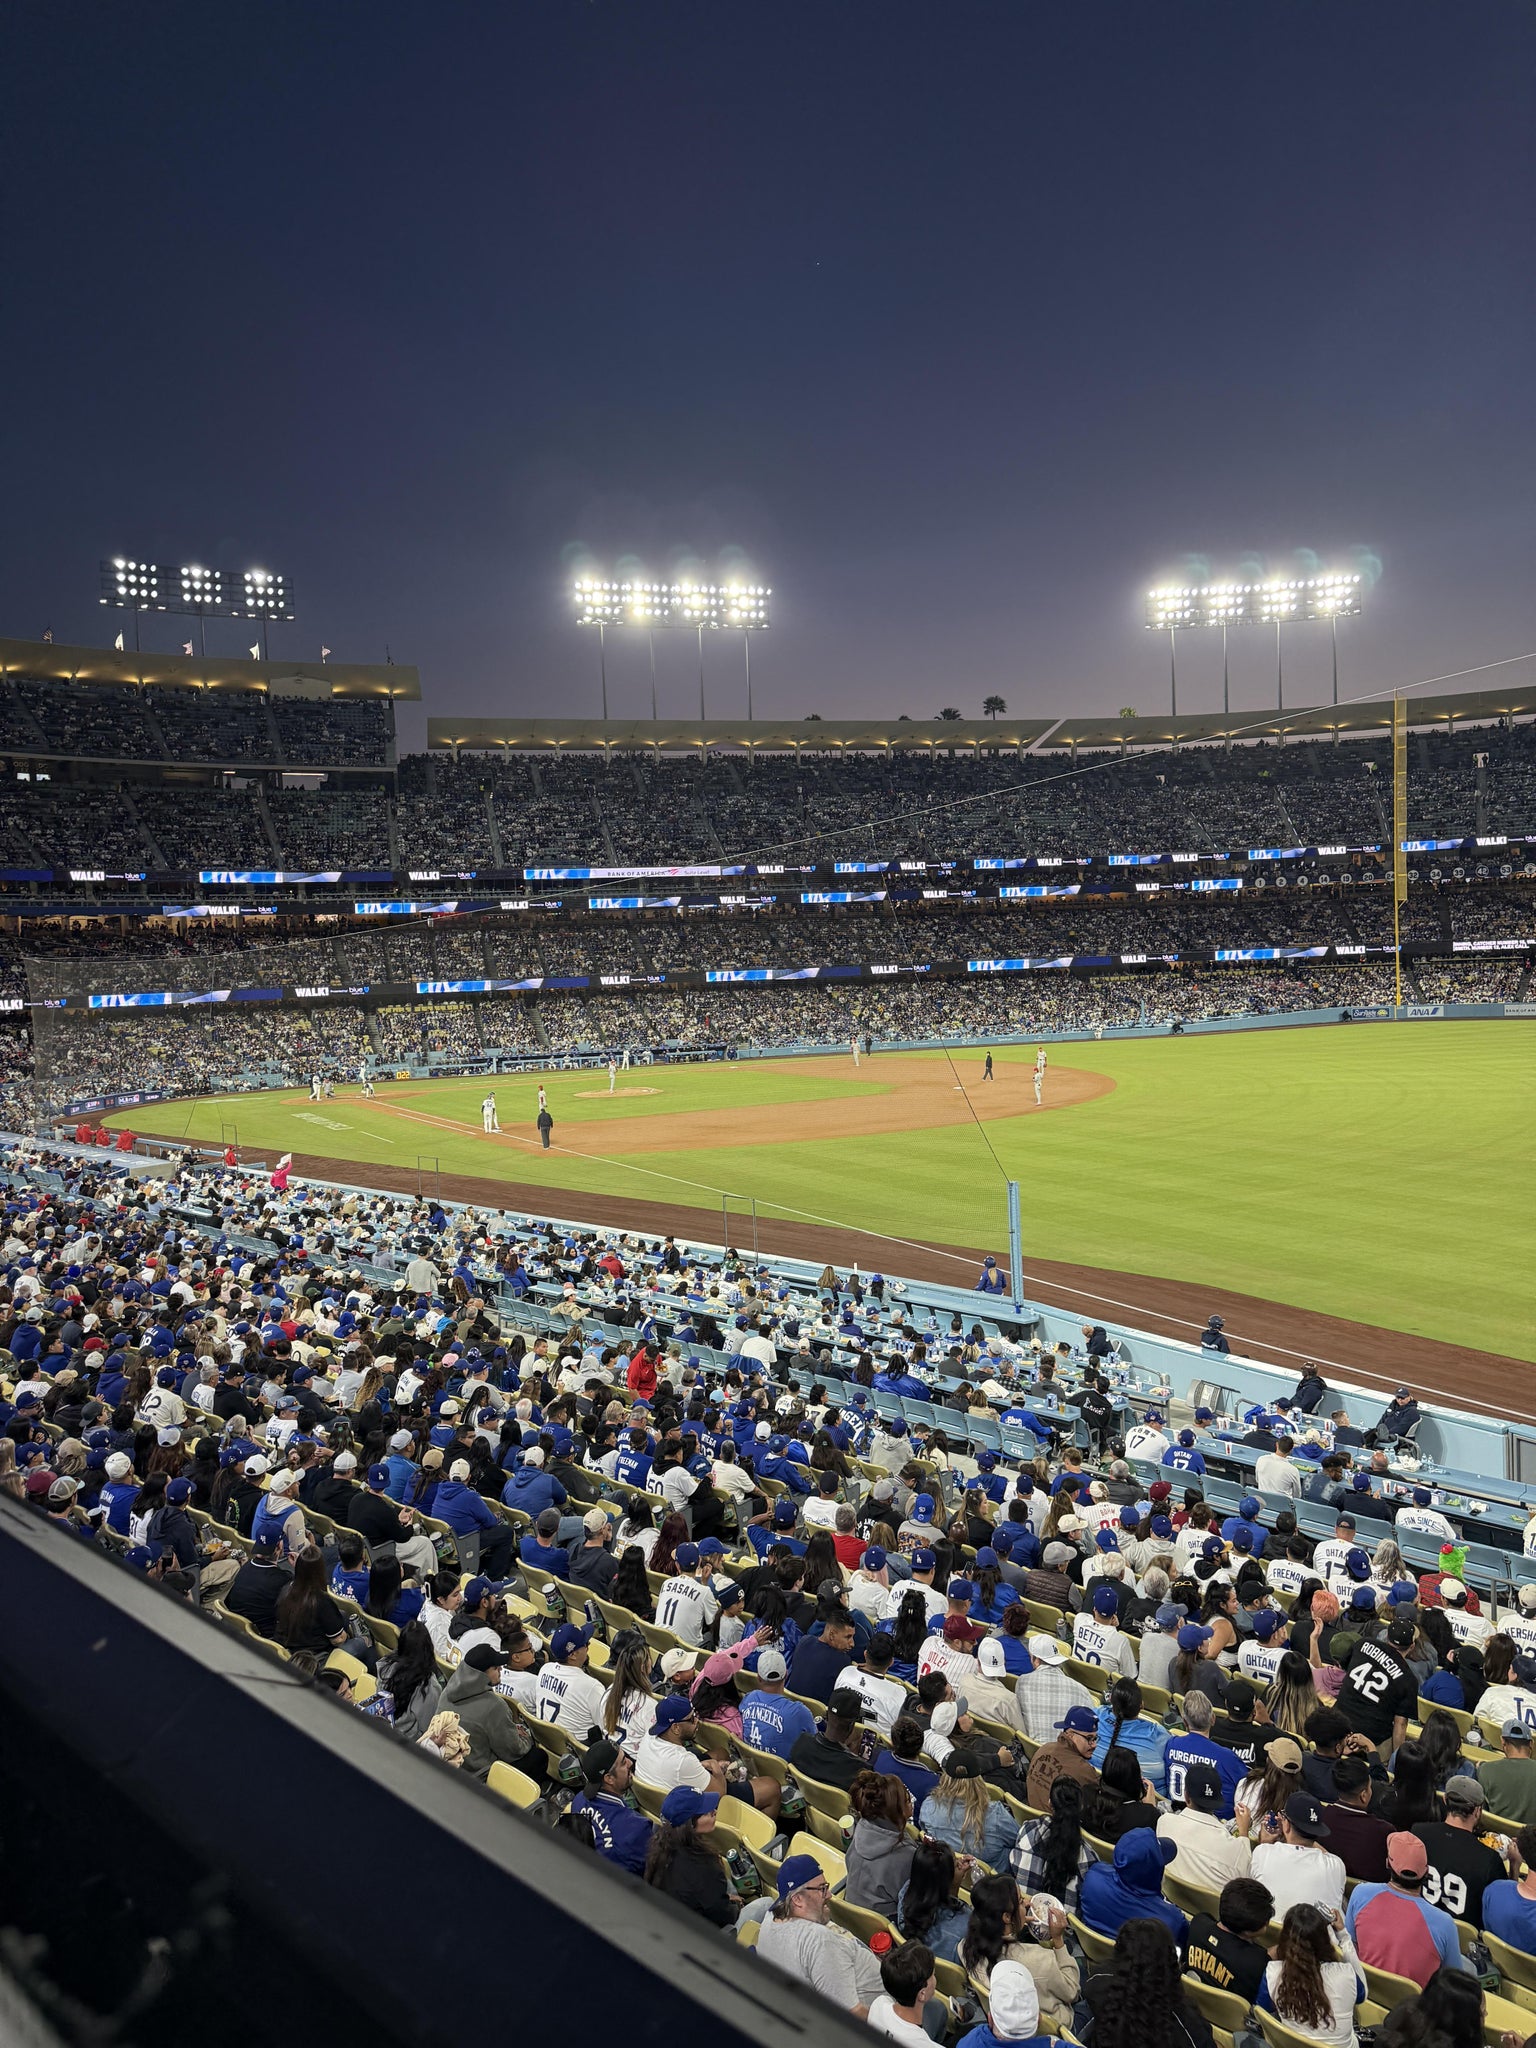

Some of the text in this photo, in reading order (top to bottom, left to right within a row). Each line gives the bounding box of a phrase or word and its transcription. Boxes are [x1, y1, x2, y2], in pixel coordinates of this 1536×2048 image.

[1410, 1008, 1429, 1016] ANA
[140, 1392, 163, 1412] 42
[1129, 1434, 1146, 1449] 17
[618, 1456, 639, 1470] FREEMAN
[1173, 1451, 1192, 1462] OHTANI
[1173, 1458, 1190, 1470] 17
[647, 1479, 663, 1497] 50
[1404, 1516, 1436, 1529] FAN SINCE
[1273, 1568, 1306, 1584] FREEMAN
[1325, 1560, 1349, 1580] 17
[667, 1582, 701, 1602] SASAKI
[662, 1597, 679, 1627] 11
[1078, 1626, 1106, 1649] BETTS
[1052, 1645, 1058, 1655] LA
[1074, 1641, 1101, 1666] 50
[928, 1651, 949, 1669] UTLEY
[991, 1655, 998, 1666] LA
[1246, 1654, 1278, 1672] OHTANI
[1360, 1641, 1404, 1680] ROBINSON
[540, 1673, 568, 1698] OHTANI
[1349, 1662, 1389, 1703] 42
[539, 1697, 560, 1723] 17
[752, 1706, 784, 1734] ANGELES
[750, 1720, 763, 1746] LA
[1204, 1783, 1214, 1797] LA
[1309, 1808, 1318, 1822] LA
[1422, 1864, 1468, 1915] 39
[1188, 1944, 1235, 1988] BRYANT
